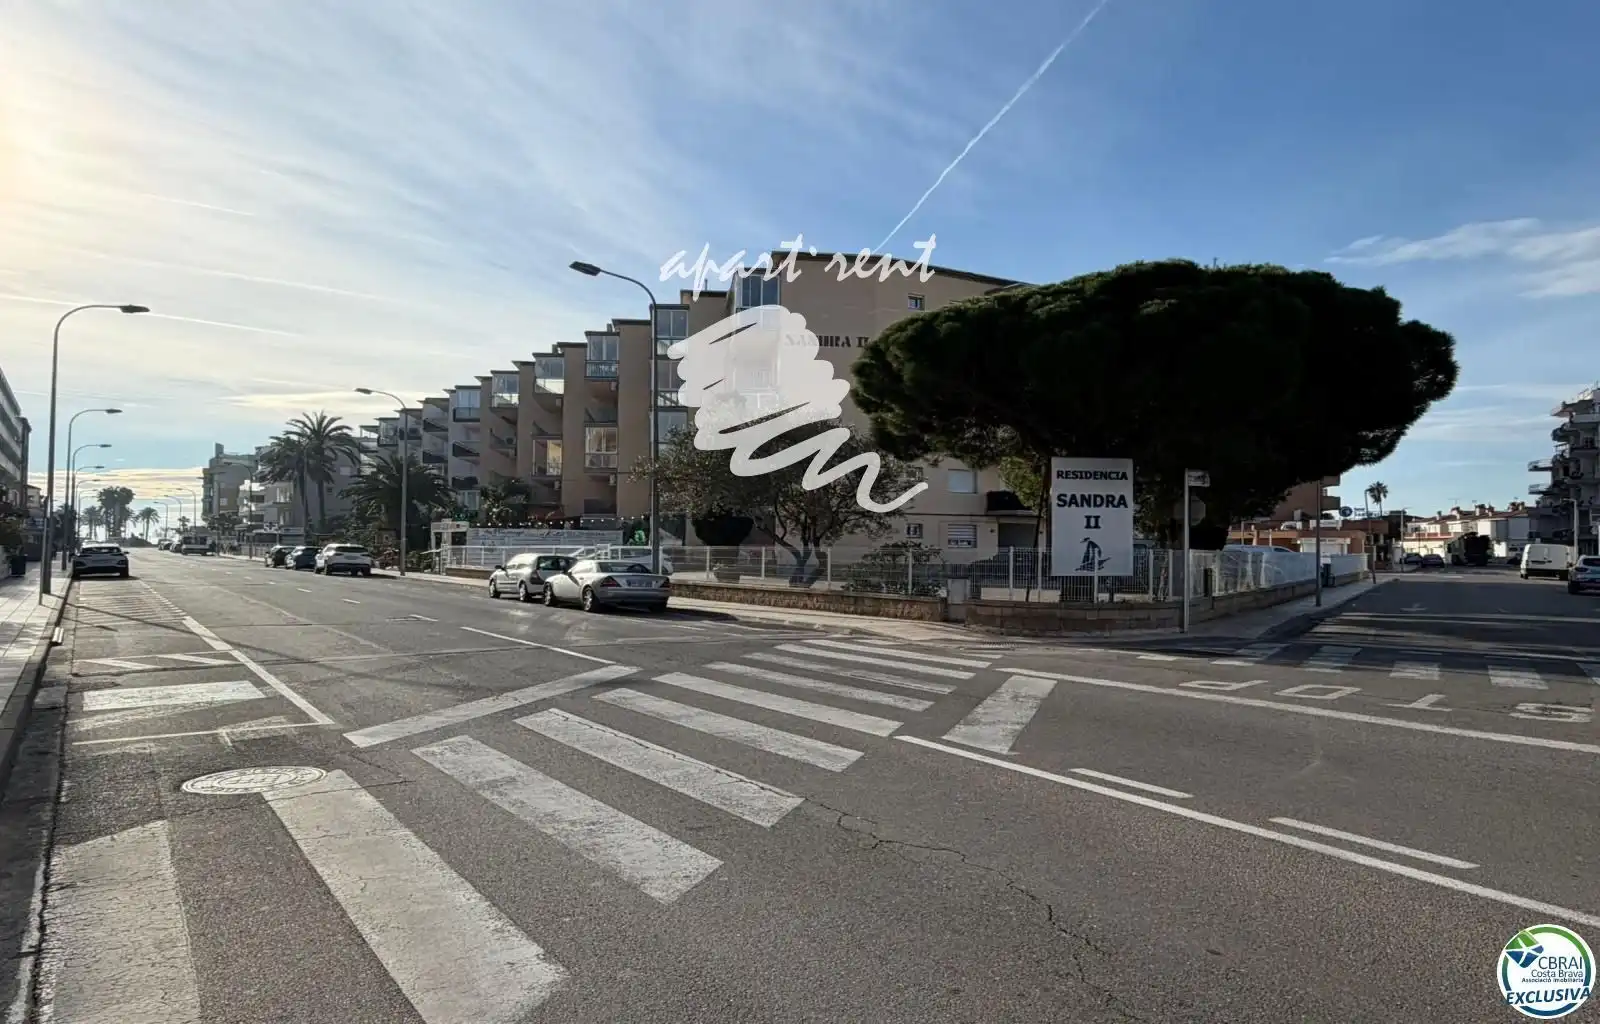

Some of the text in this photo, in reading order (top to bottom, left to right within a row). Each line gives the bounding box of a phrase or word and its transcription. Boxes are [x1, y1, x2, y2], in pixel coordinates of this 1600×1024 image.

[1056, 470, 1128, 481] RESIDENCIA
[1056, 493, 1128, 509] SANDRA
[1084, 515, 1101, 529] II
